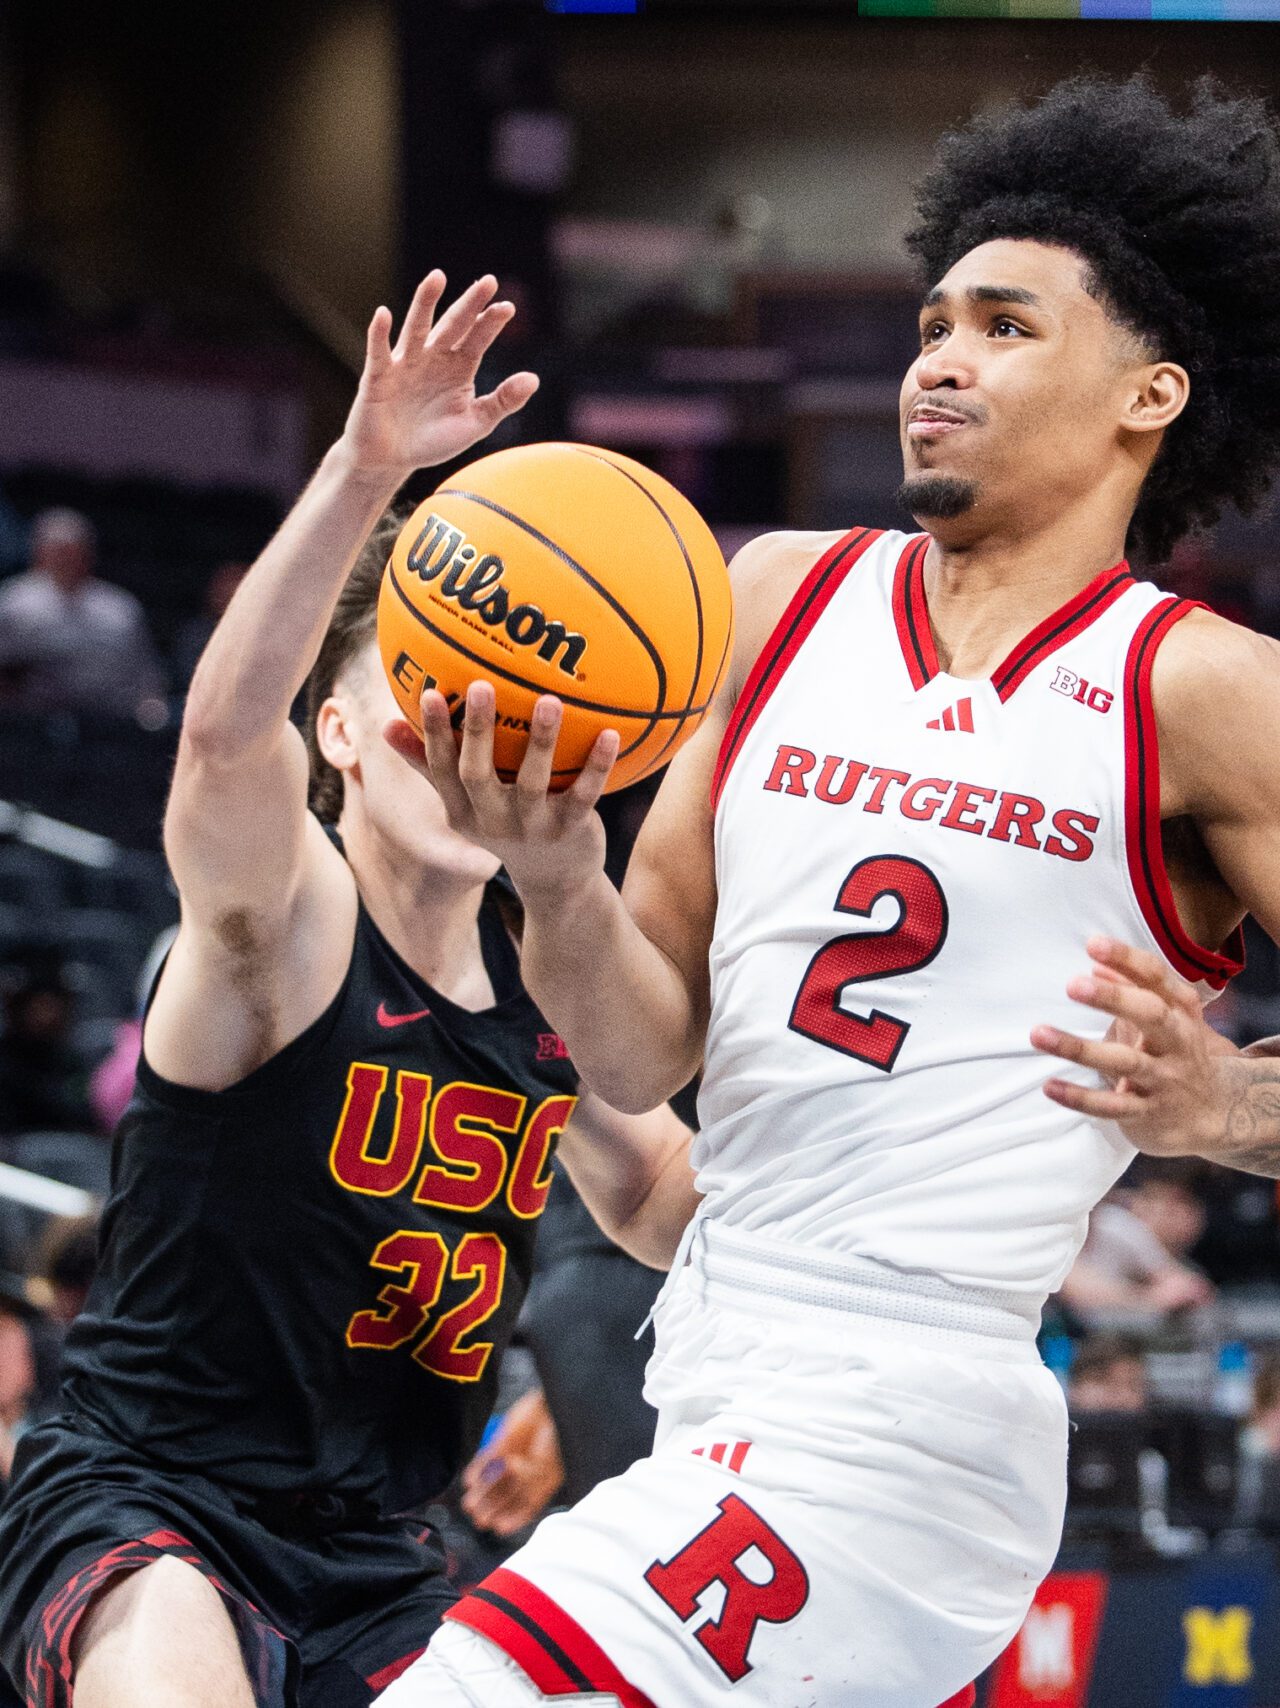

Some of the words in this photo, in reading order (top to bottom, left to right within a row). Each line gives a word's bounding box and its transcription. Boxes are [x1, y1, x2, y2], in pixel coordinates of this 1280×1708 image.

[406, 512, 588, 679] Wilson
[461, 616, 488, 637] GAME
[490, 634, 515, 655] BALL
[763, 744, 1101, 862] RUTGERS
[787, 853, 949, 1073] 2
[329, 1061, 580, 1219] USC
[346, 1229, 507, 1383] 32
[643, 1491, 810, 1684] R
